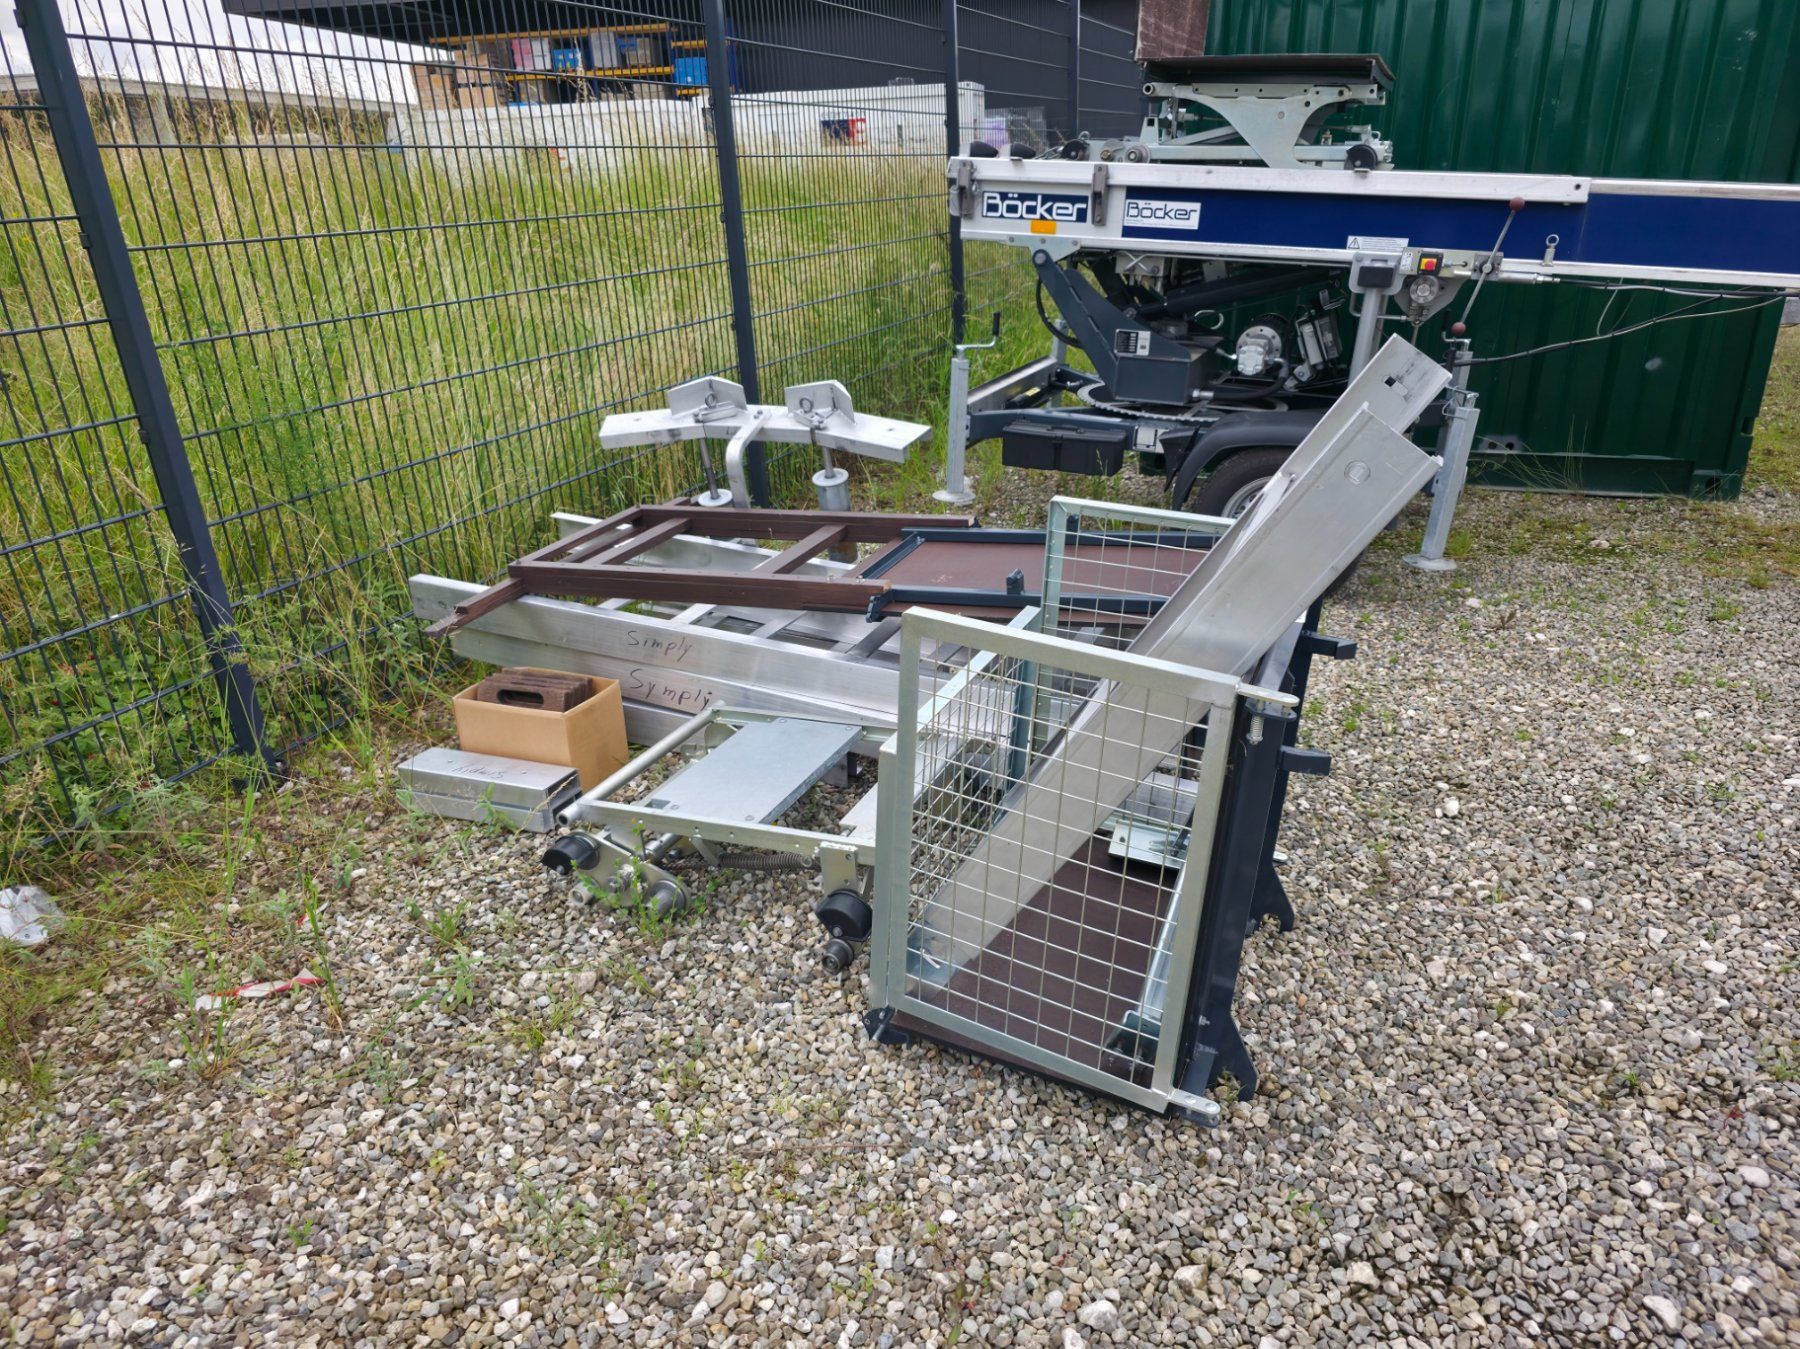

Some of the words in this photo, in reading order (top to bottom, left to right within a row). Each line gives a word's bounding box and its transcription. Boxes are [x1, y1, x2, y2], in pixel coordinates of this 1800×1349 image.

[983, 192, 1087, 221] Böcker
[1126, 202, 1198, 221] Böcker
[627, 630, 693, 662] Simply
